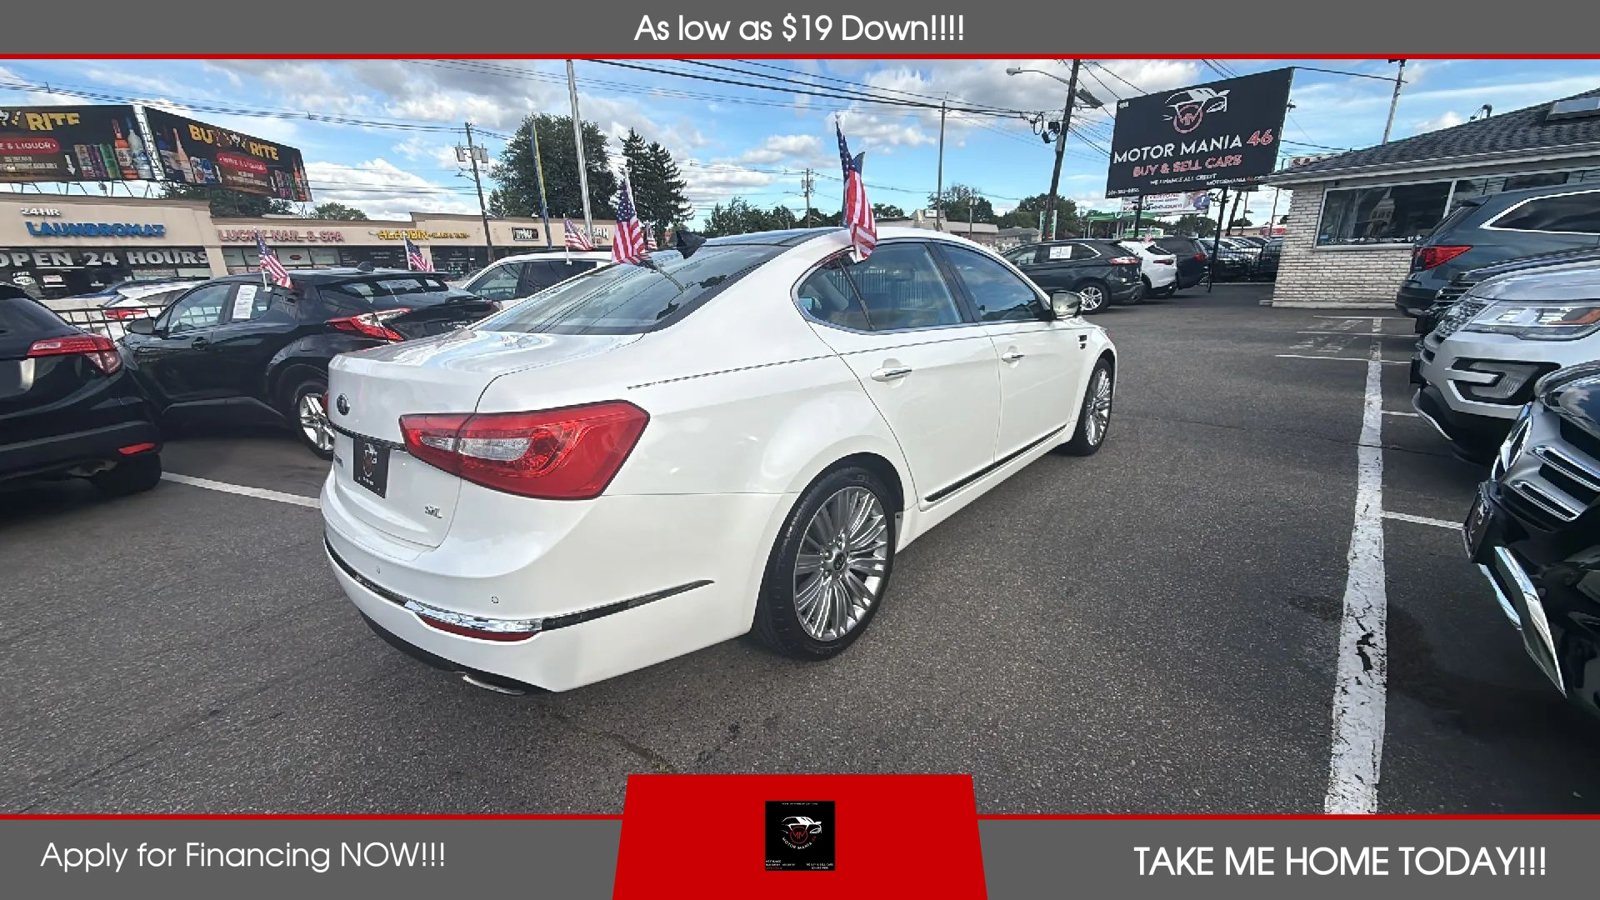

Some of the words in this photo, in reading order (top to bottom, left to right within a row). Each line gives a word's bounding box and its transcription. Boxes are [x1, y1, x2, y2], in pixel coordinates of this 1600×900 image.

[25, 112, 80, 131] RITE
[15, 142, 52, 150] LIQUOR
[249, 141, 279, 161] RITE
[1113, 143, 1174, 164] MOTOR
[1180, 135, 1242, 156] MANIA
[1246, 129, 1274, 147] 46
[1132, 164, 1160, 178] BUY
[1160, 163, 1170, 175] &
[1172, 159, 1202, 173] SELL
[1205, 154, 1243, 169] CARS
[20, 207, 61, 216] 24HR
[26, 221, 167, 237] LAUNDROMAT
[218, 230, 267, 242] LUCKY
[271, 231, 302, 242] NAIL
[320, 231, 343, 242] SPA
[0, 252, 74, 267] OPEN
[86, 252, 119, 266] 24
[127, 250, 209, 265] HOURS
